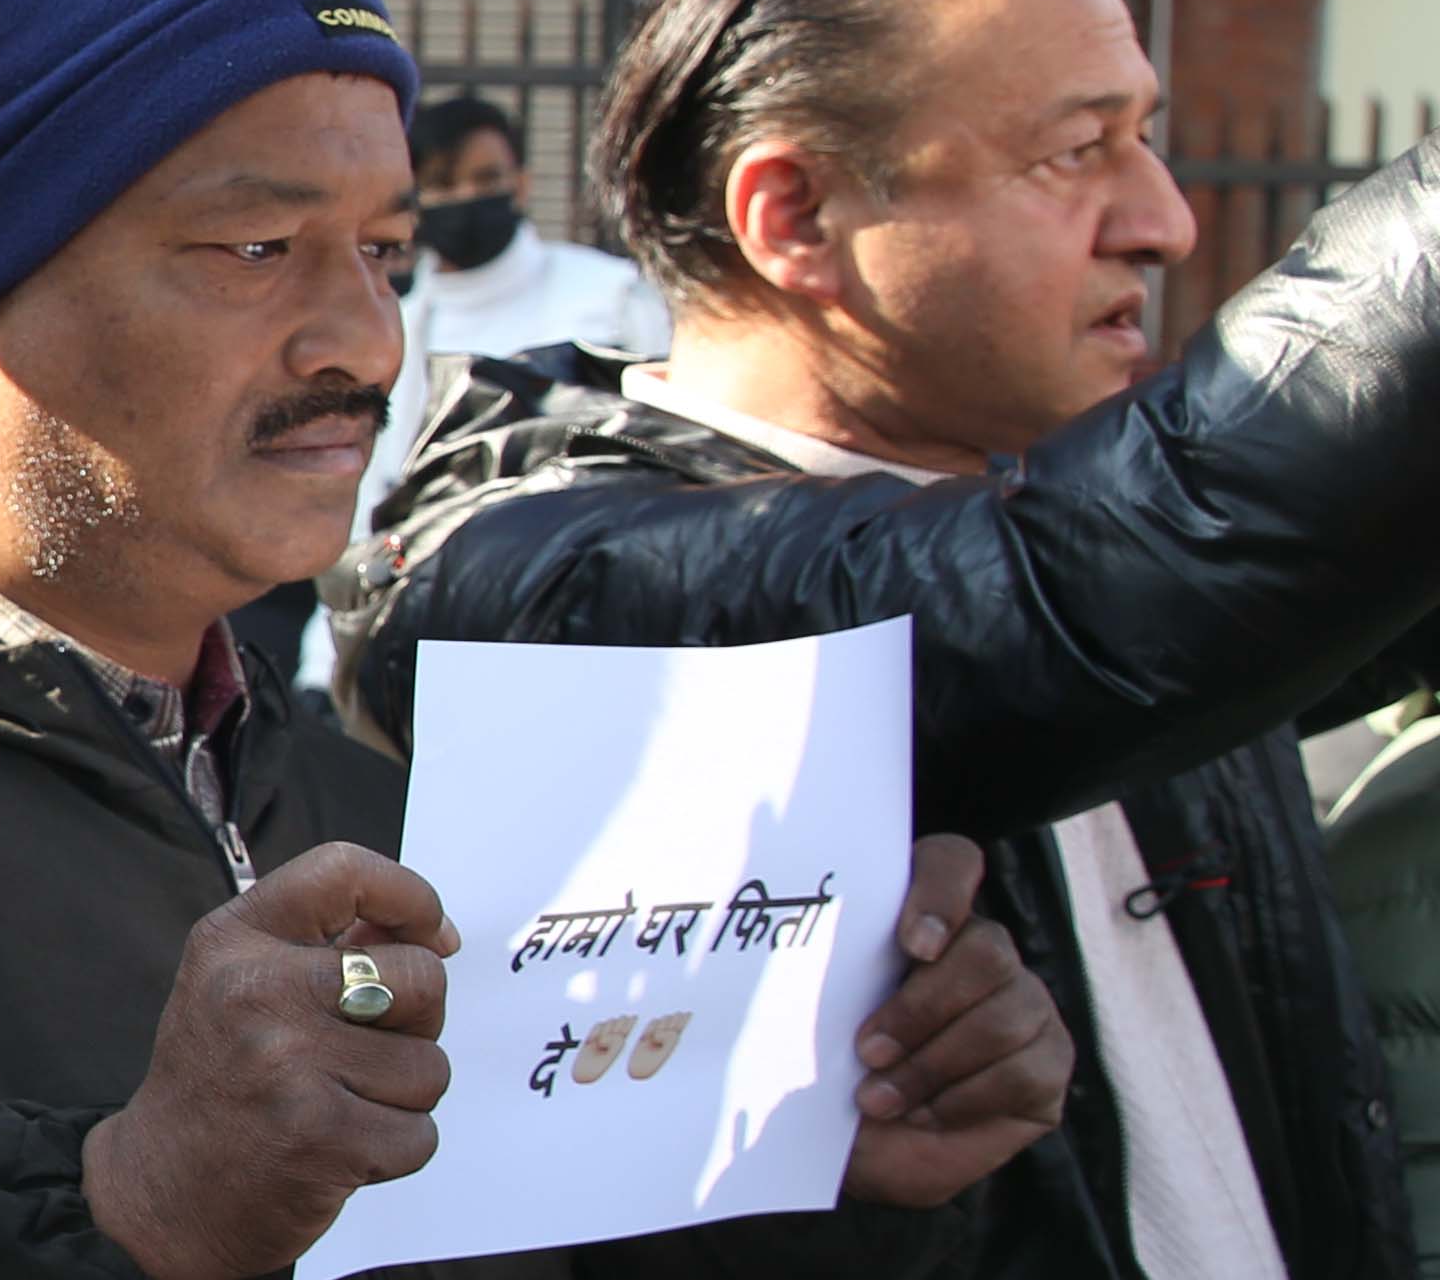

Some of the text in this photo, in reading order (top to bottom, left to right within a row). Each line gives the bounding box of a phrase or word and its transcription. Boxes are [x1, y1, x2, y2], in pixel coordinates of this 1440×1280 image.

[511, 871, 834, 973] हाम्रो घर फिर्ता
[529, 1022, 582, 1098] दे
